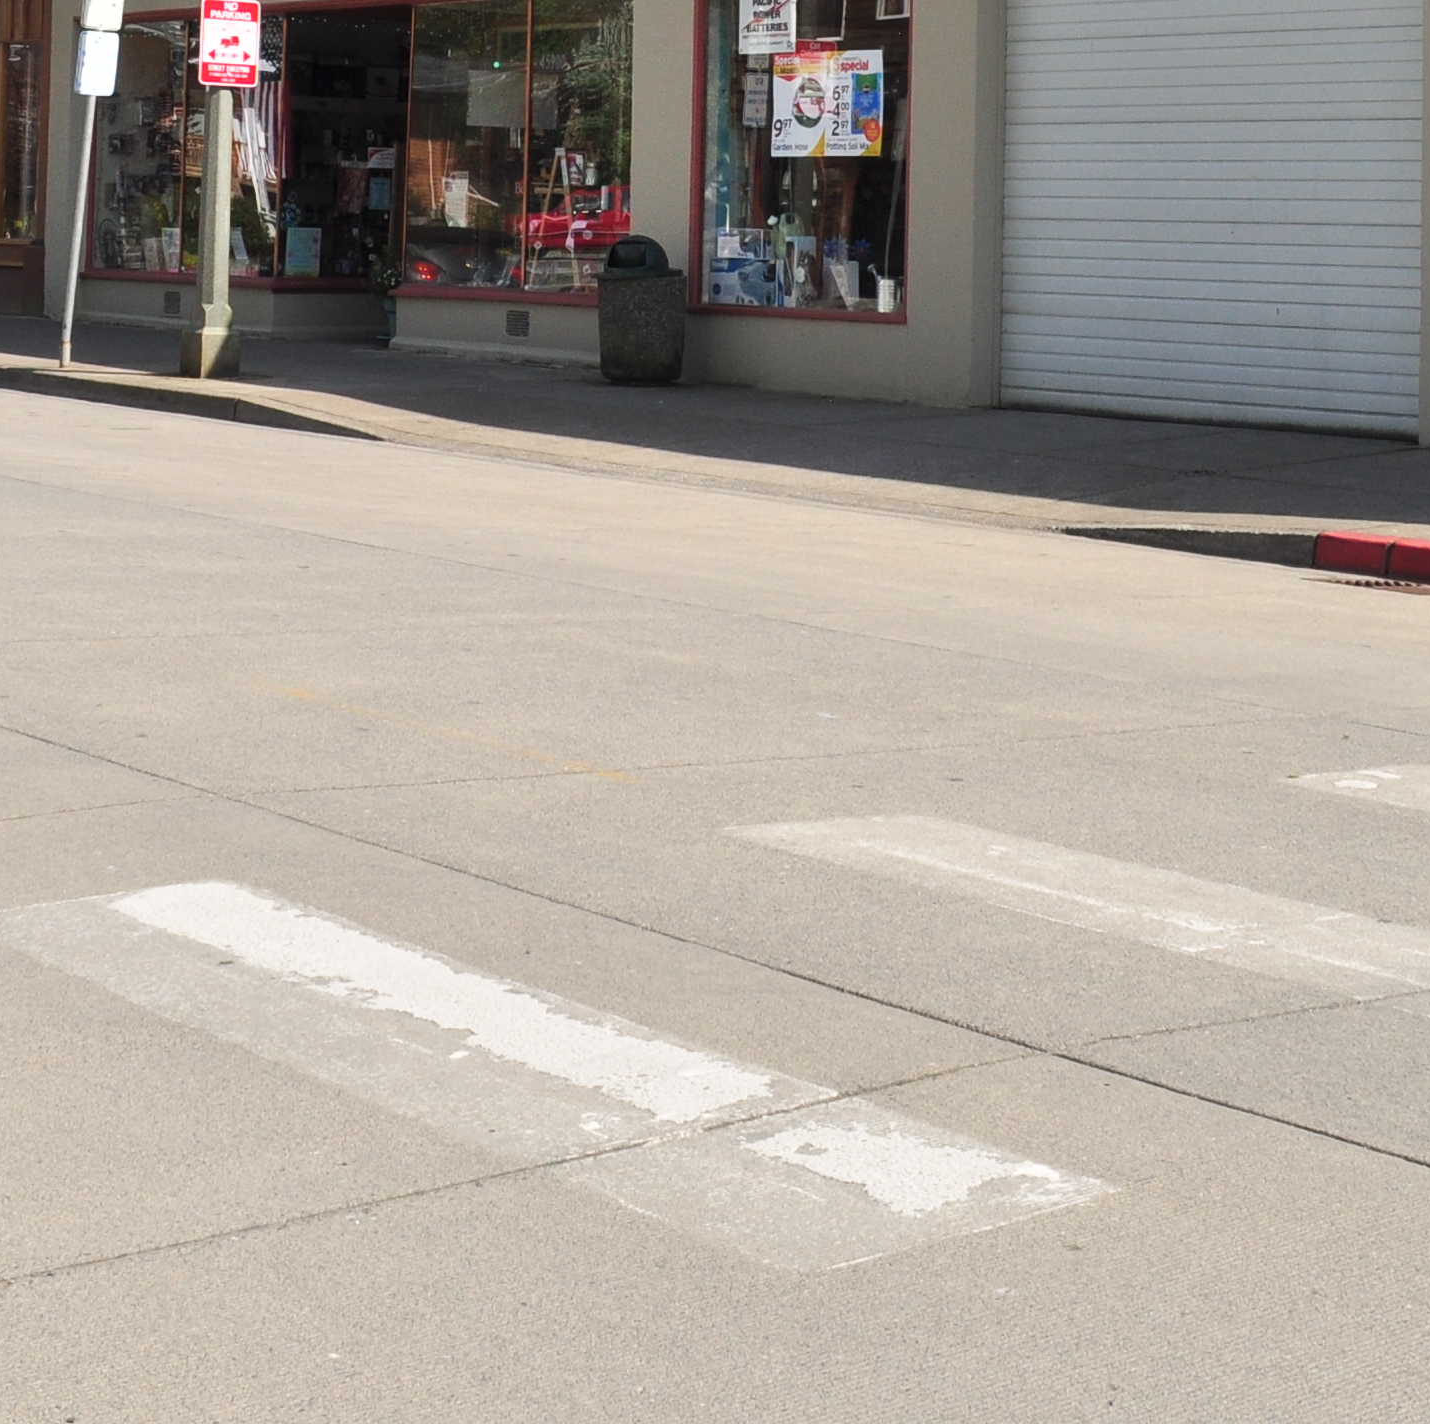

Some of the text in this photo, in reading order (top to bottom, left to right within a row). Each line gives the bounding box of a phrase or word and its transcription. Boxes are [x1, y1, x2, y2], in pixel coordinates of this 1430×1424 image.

[223, 2, 239, 11] NO
[210, 10, 251, 20] PARKING
[753, 11, 781, 19] POWER
[746, 22, 789, 33] BATTERIES
[840, 60, 869, 73] special
[773, 143, 793, 151] Garden
